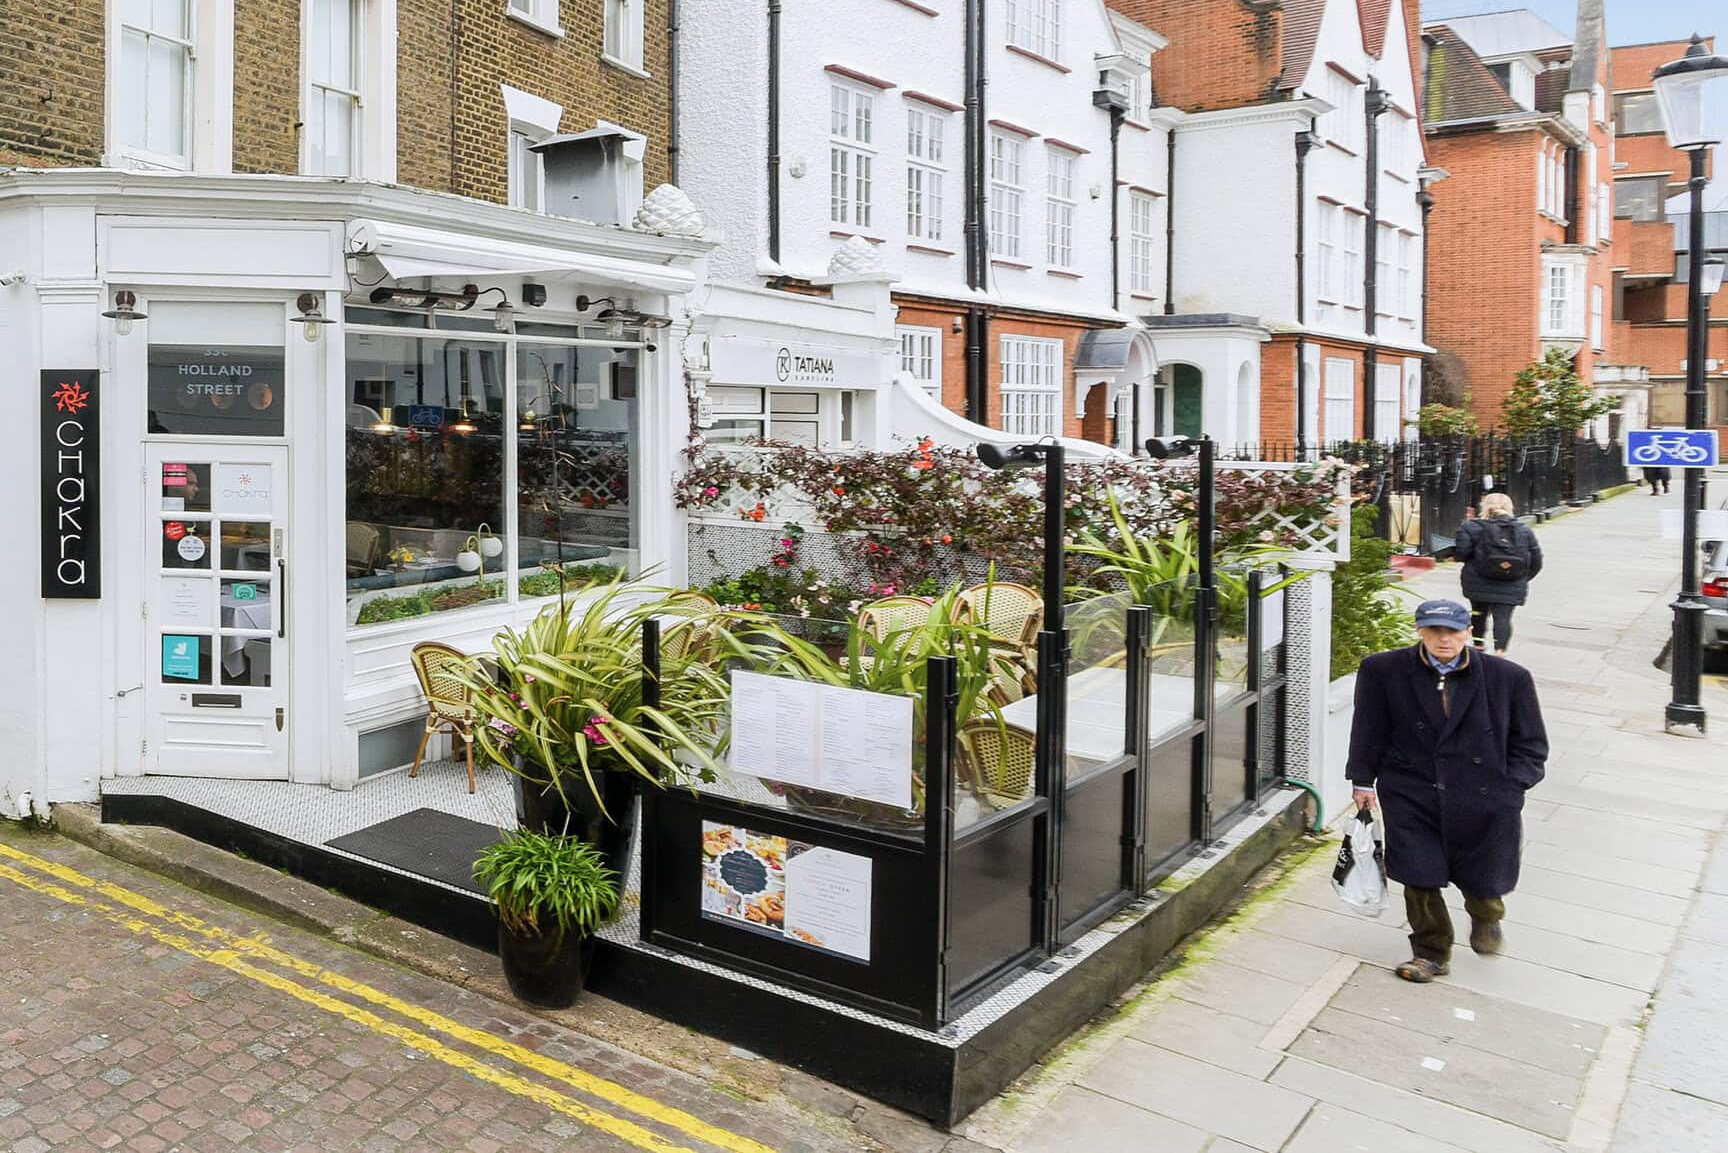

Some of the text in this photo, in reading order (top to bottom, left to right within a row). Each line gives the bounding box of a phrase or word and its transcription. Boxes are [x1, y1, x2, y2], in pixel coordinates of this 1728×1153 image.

[178, 365, 252, 376] HOLLAND
[795, 356, 834, 374] TATIANA
[186, 384, 243, 395] STREET
